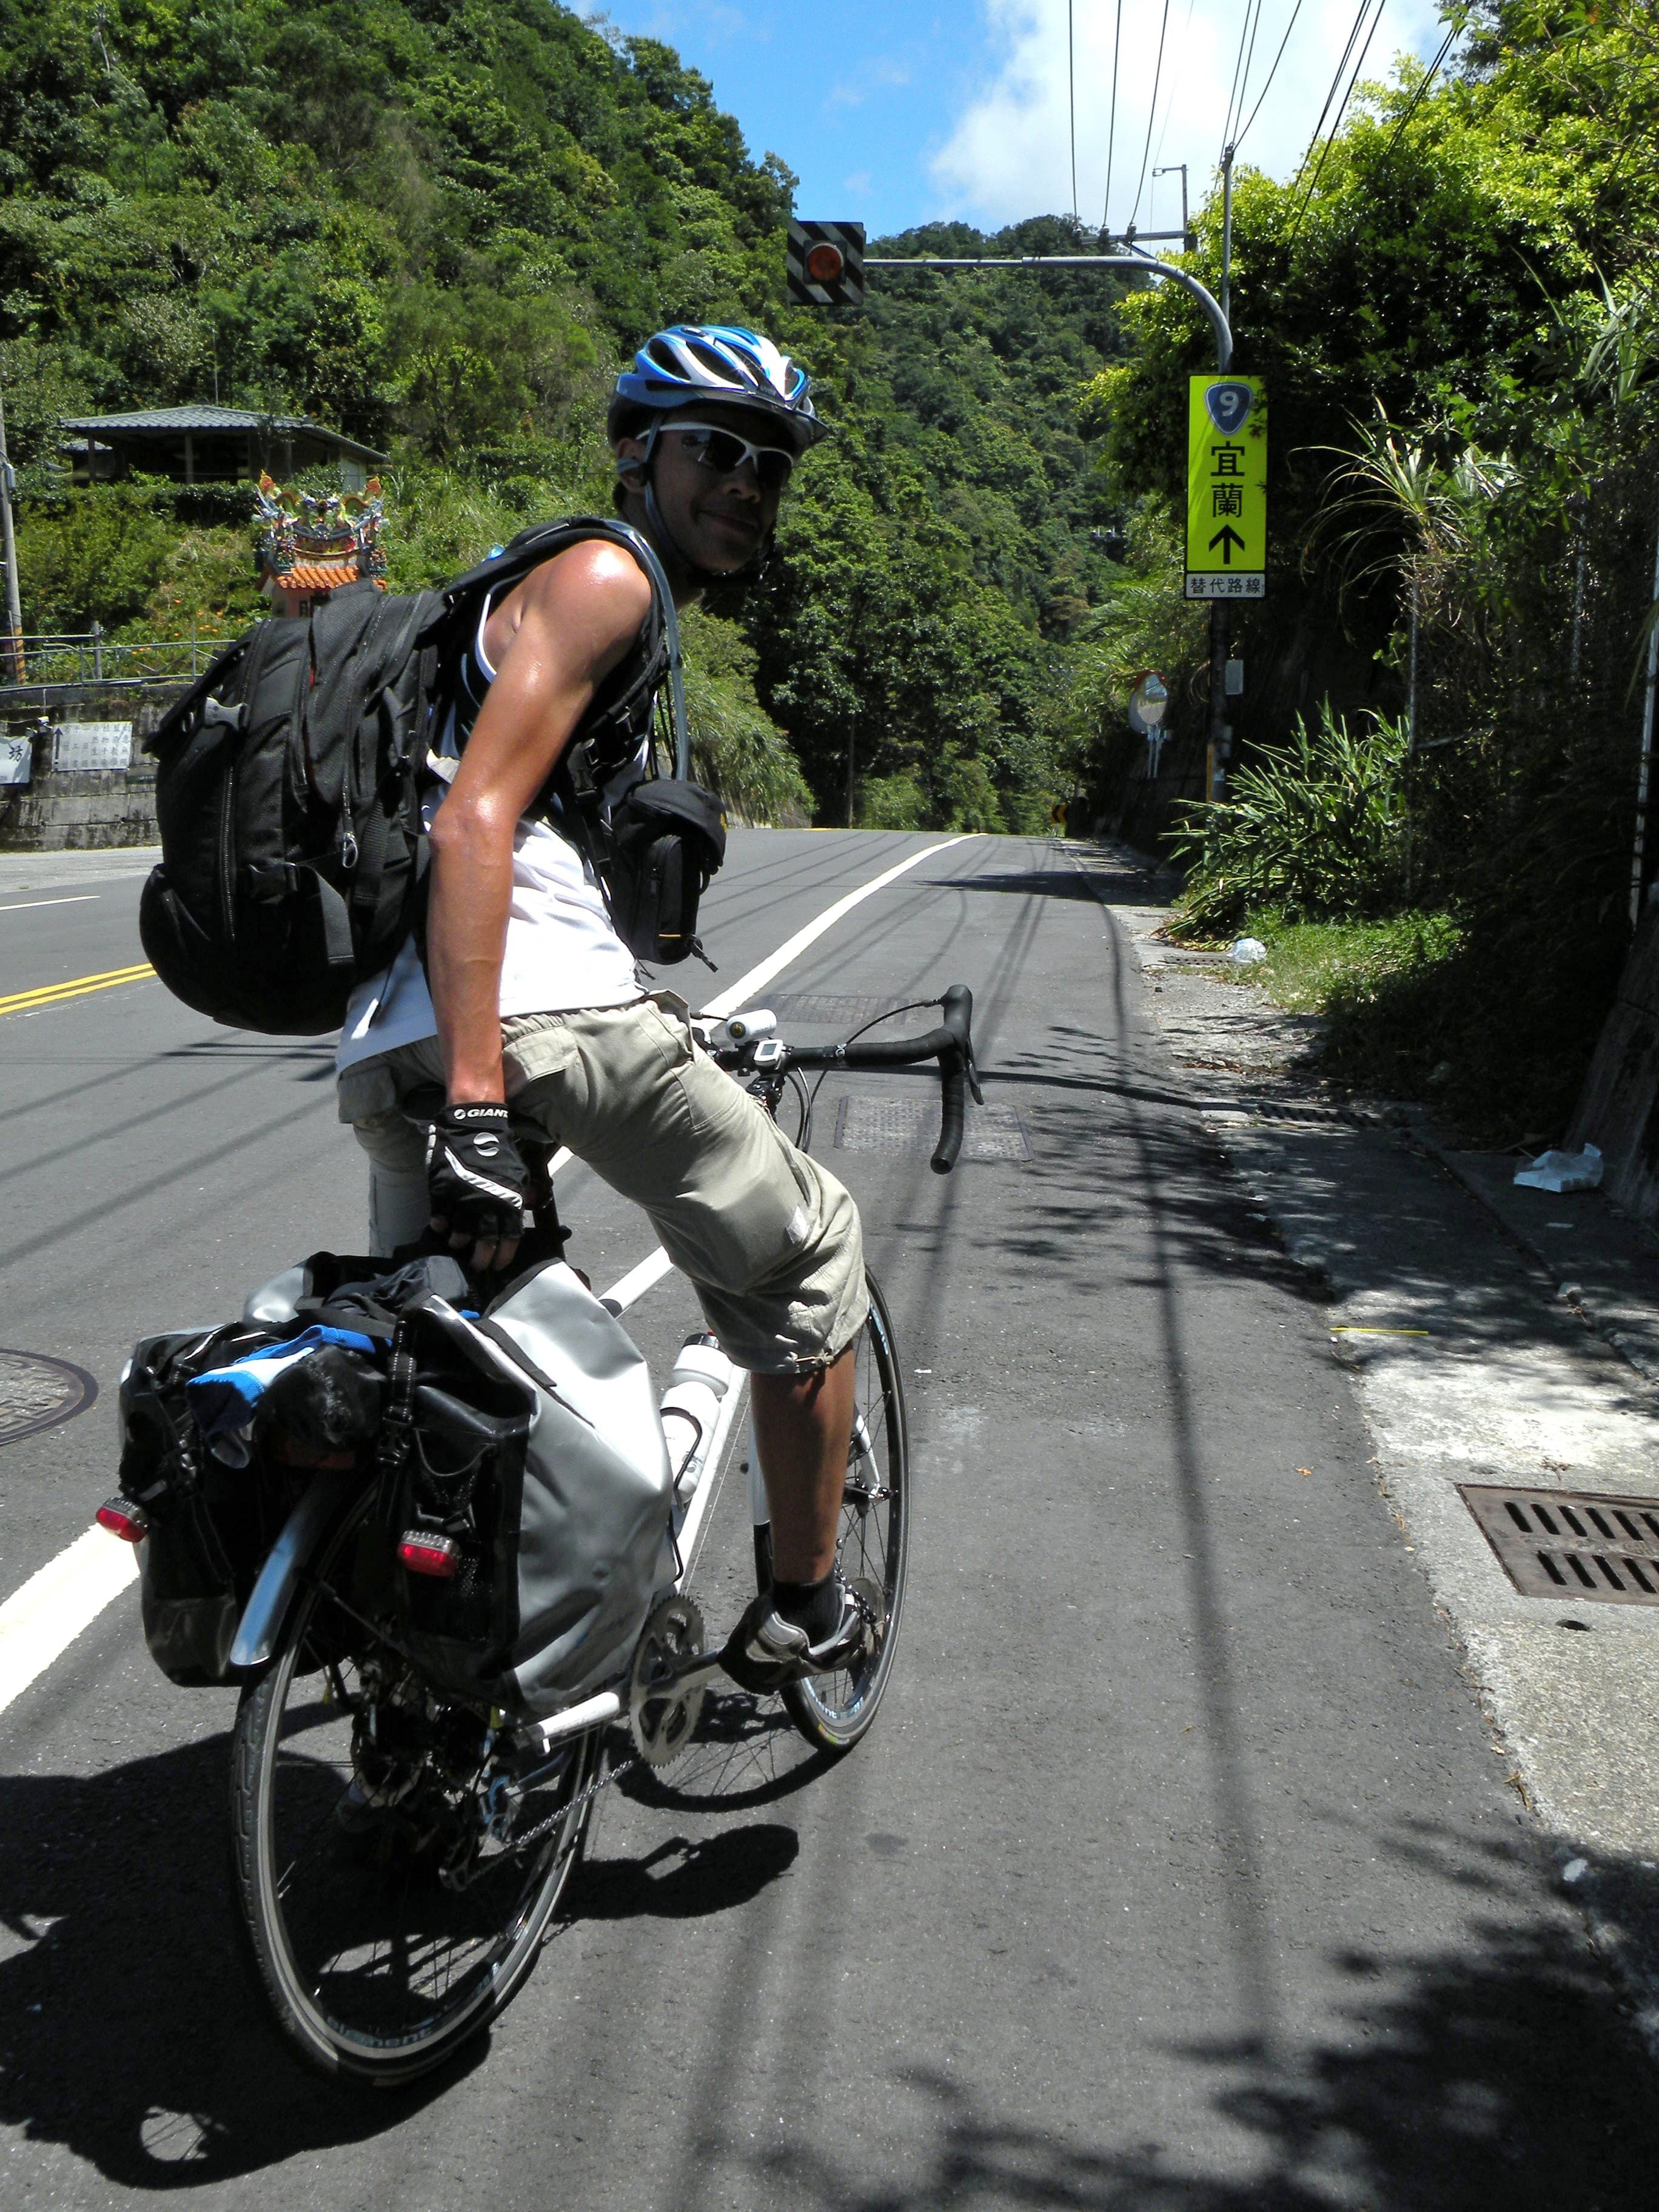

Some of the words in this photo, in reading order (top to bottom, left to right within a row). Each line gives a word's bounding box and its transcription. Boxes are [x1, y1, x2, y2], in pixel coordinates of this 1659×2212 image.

[1219, 390, 1239, 417] 9
[1210, 441, 1245, 518] 宜蘭
[1190, 577, 1263, 594] 替代路線
